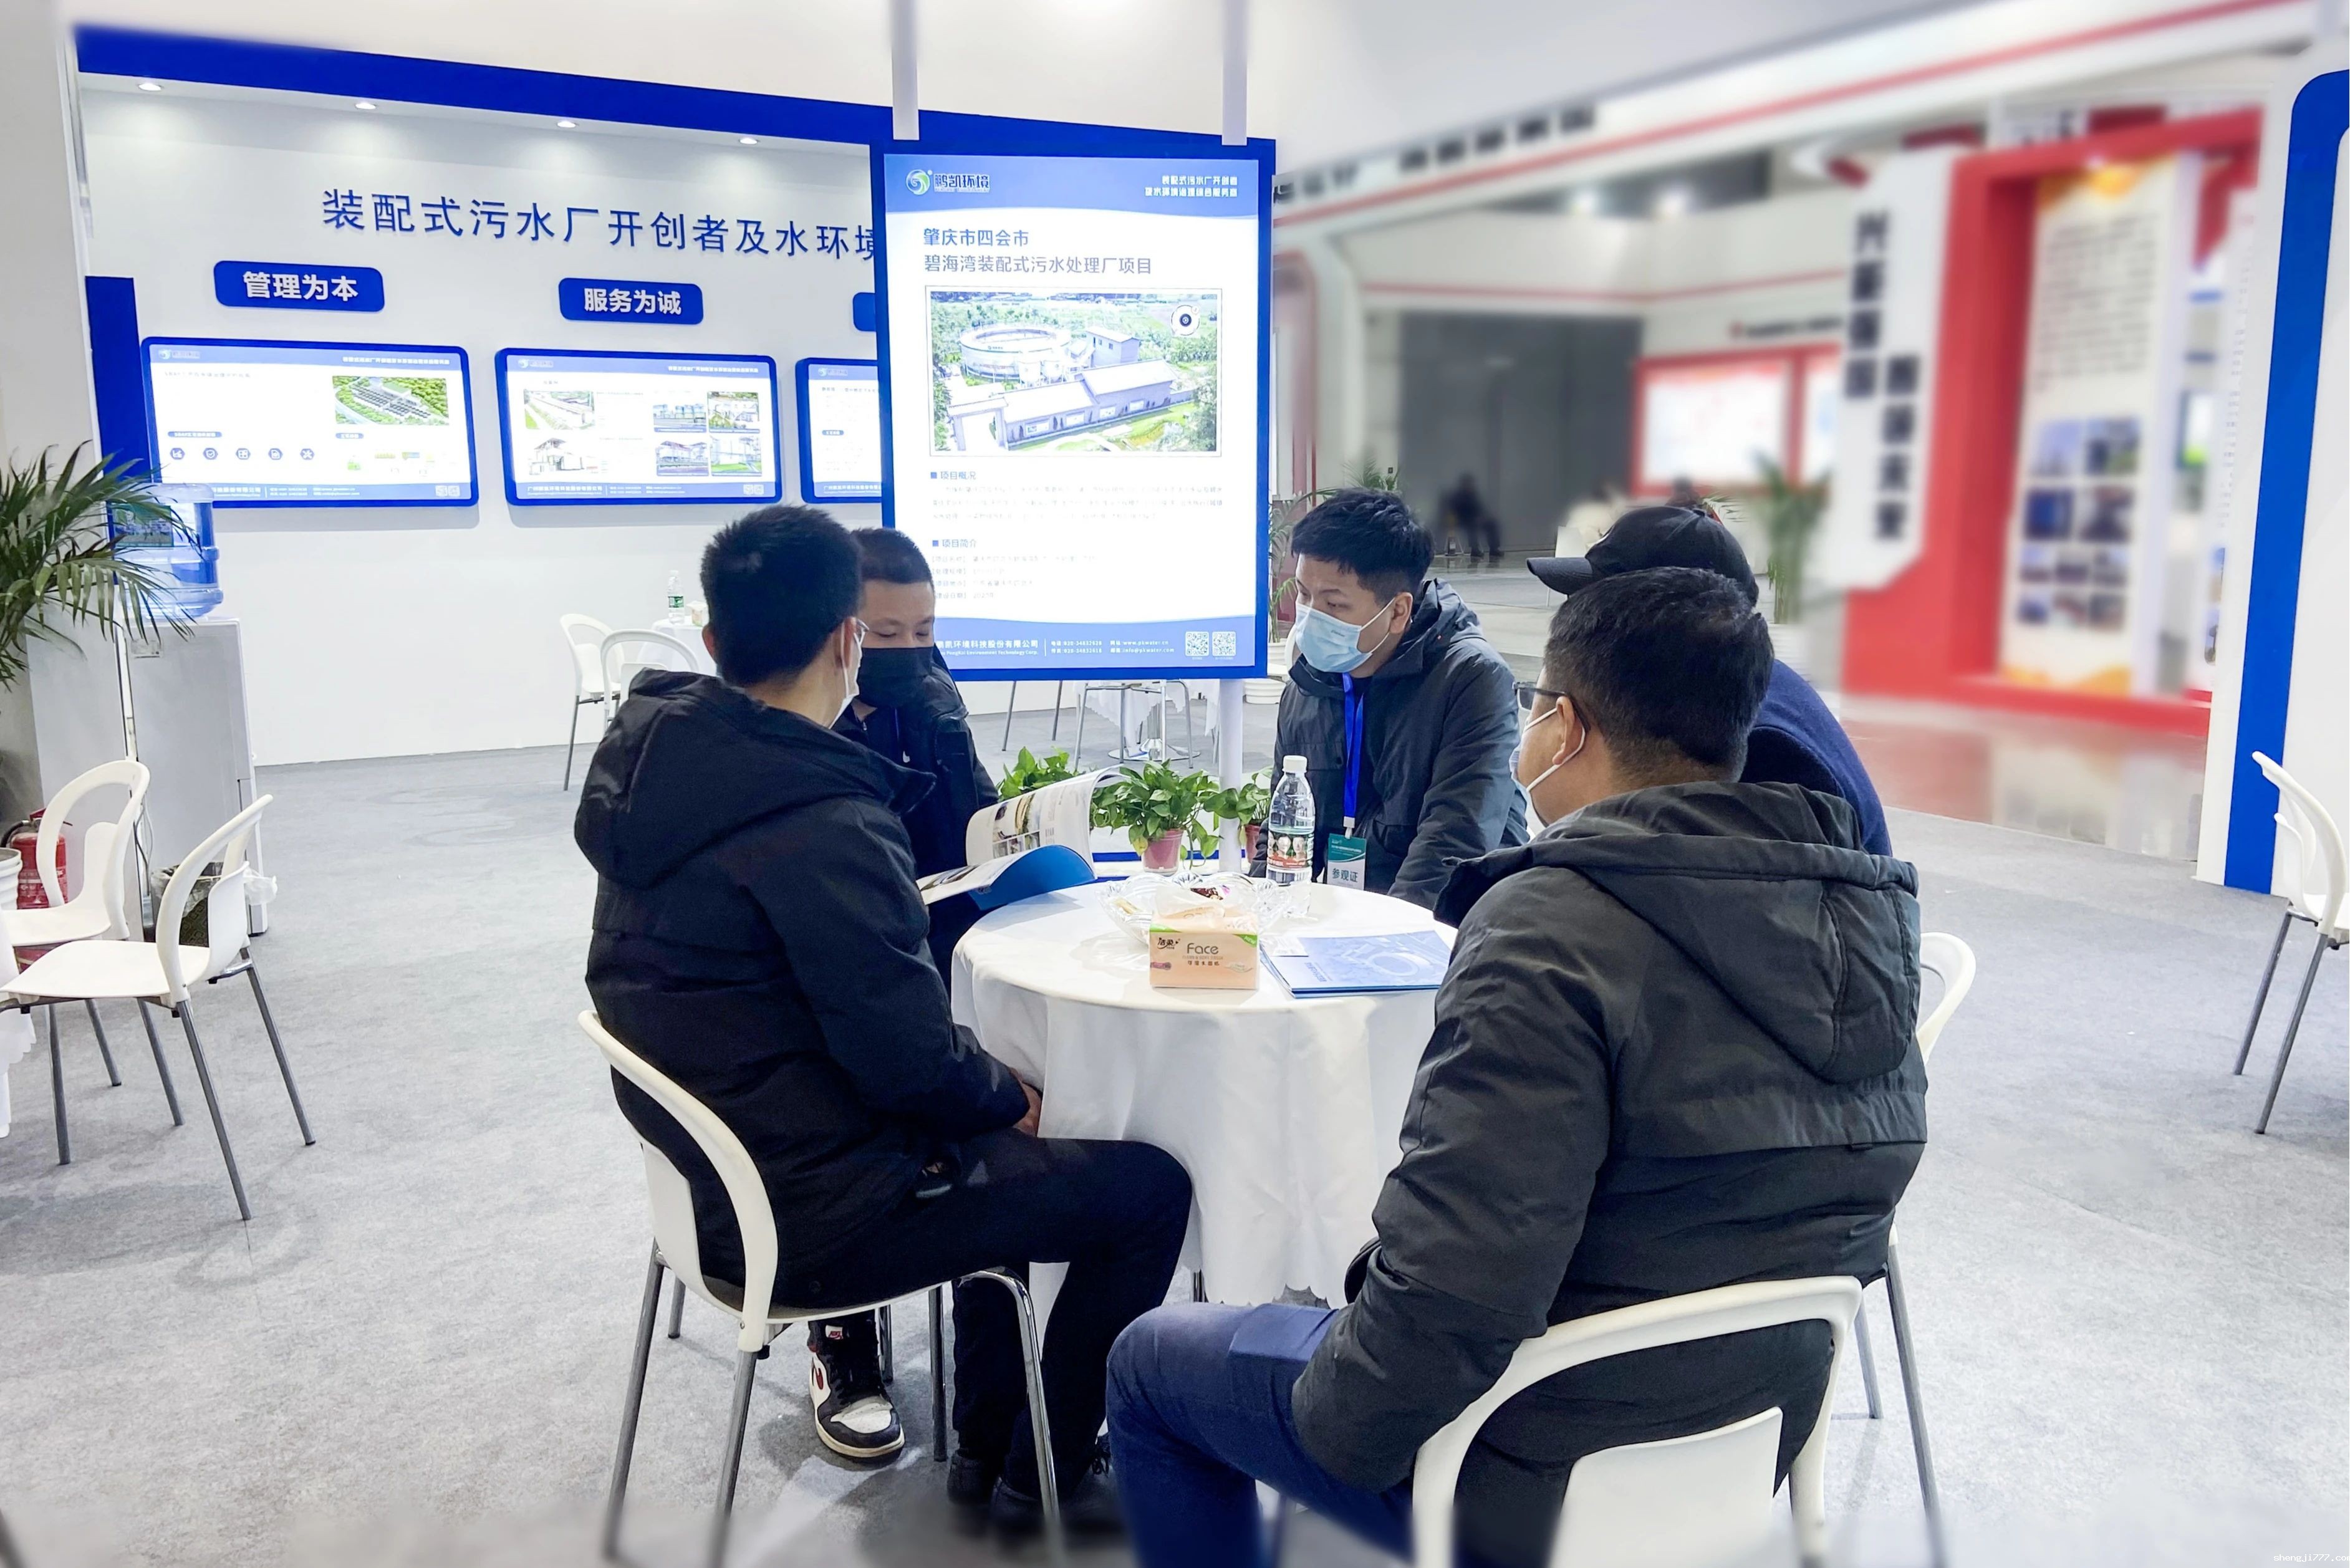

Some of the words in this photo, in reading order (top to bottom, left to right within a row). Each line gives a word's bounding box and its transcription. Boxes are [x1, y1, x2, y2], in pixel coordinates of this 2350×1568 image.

[934, 174, 990, 188] 鹏凯环境
[1162, 175, 1238, 186] 装配式污水厂开创者
[322, 188, 875, 261] 装配式污水厂开创者及水环境
[923, 228, 1029, 247] 肇庆市四会市
[924, 254, 1152, 275] 碧海湾装配式污水处理厂项目
[242, 271, 360, 303] 管理为本
[584, 287, 682, 315] 服务为诚
[940, 471, 976, 480] 项目概况
[942, 539, 978, 548] 项目简介
[1332, 868, 1359, 883] 参观证
[1187, 943, 1219, 955] Face
